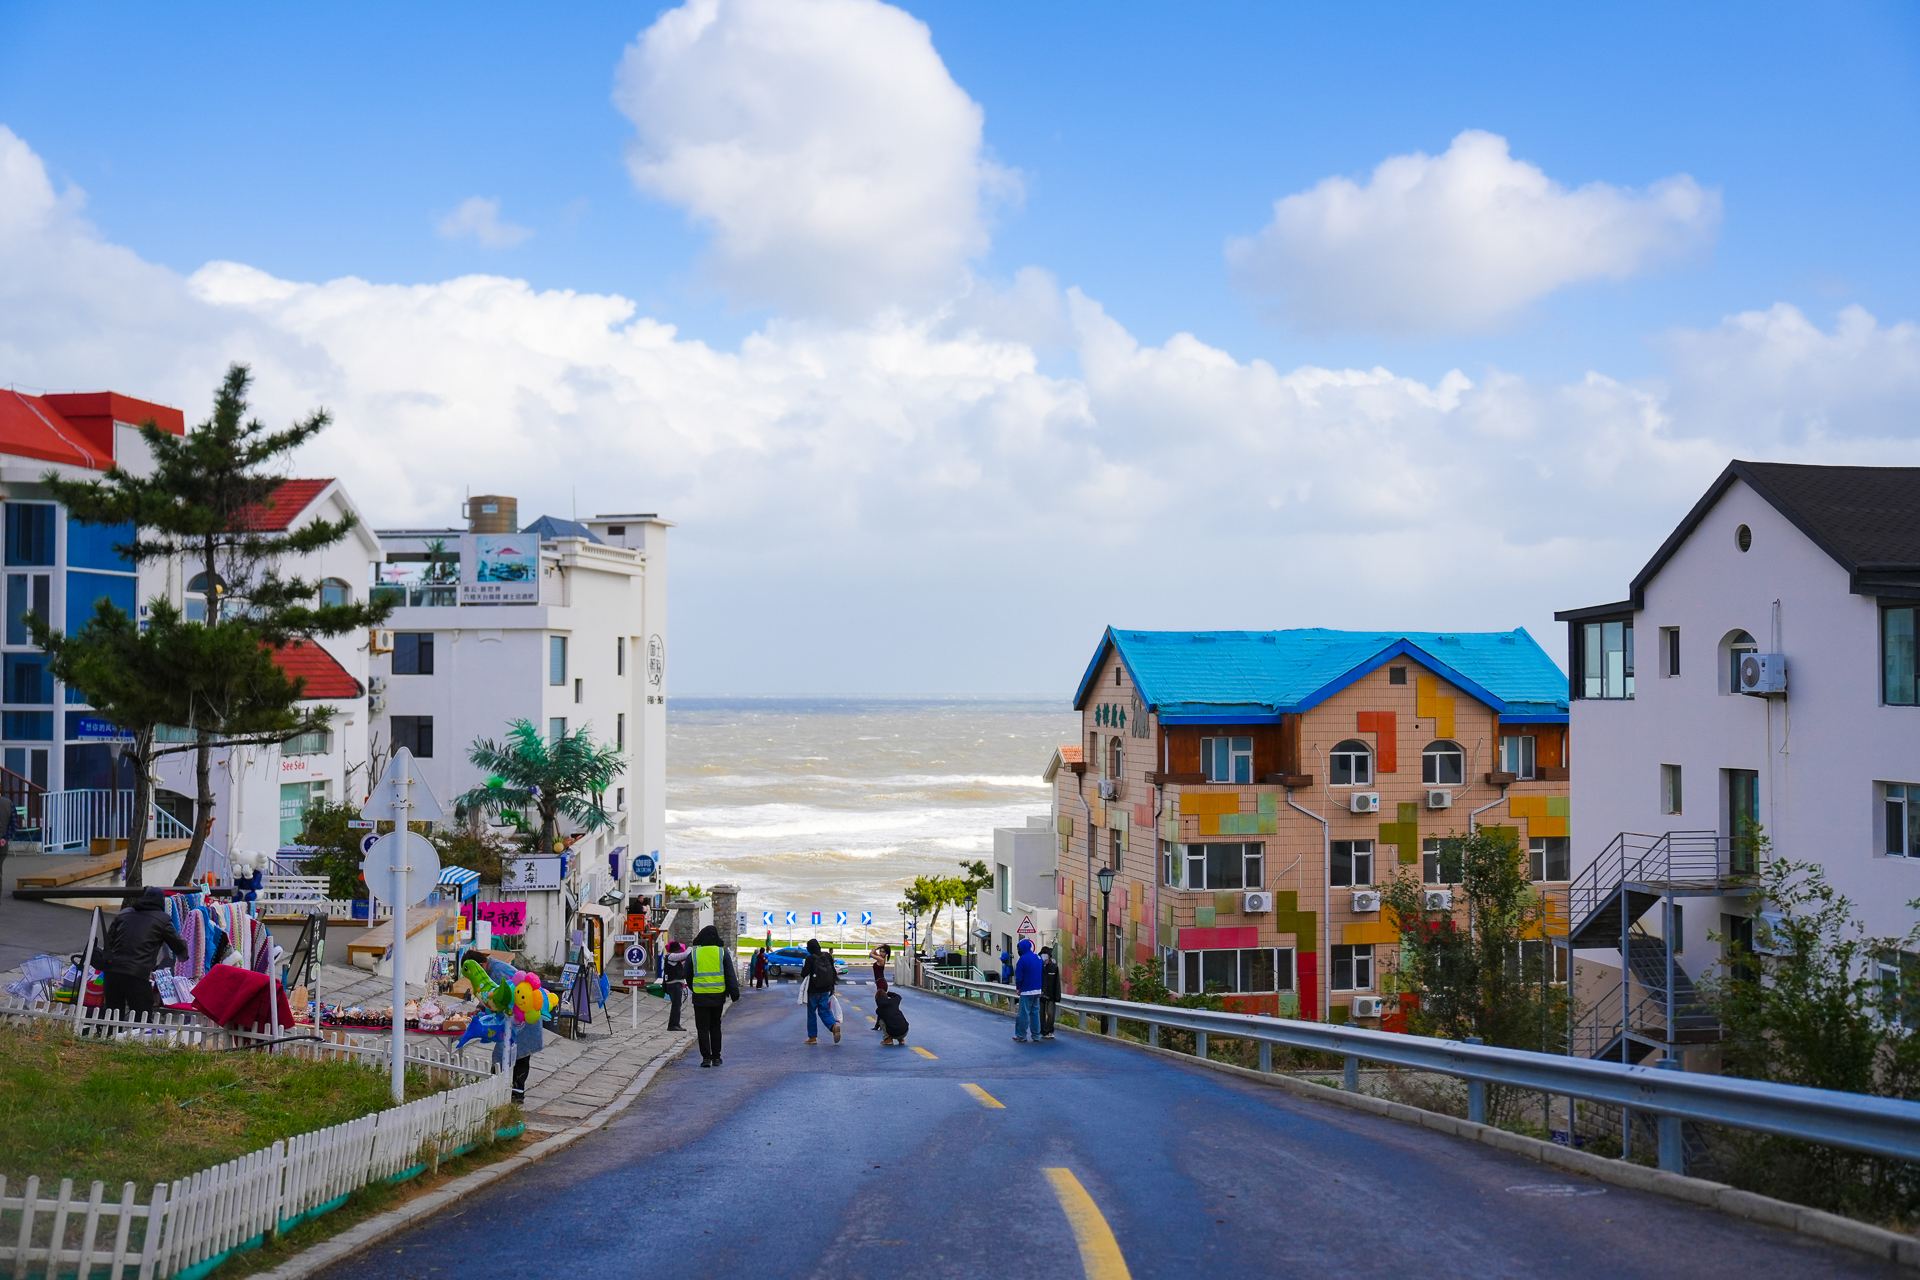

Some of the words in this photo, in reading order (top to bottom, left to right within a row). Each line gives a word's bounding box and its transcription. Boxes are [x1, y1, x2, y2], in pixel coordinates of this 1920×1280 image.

[282, 761, 294, 772] See
[294, 760, 305, 770] Sea
[635, 858, 652, 867] 咖啡
[524, 860, 535, 884] 望海
